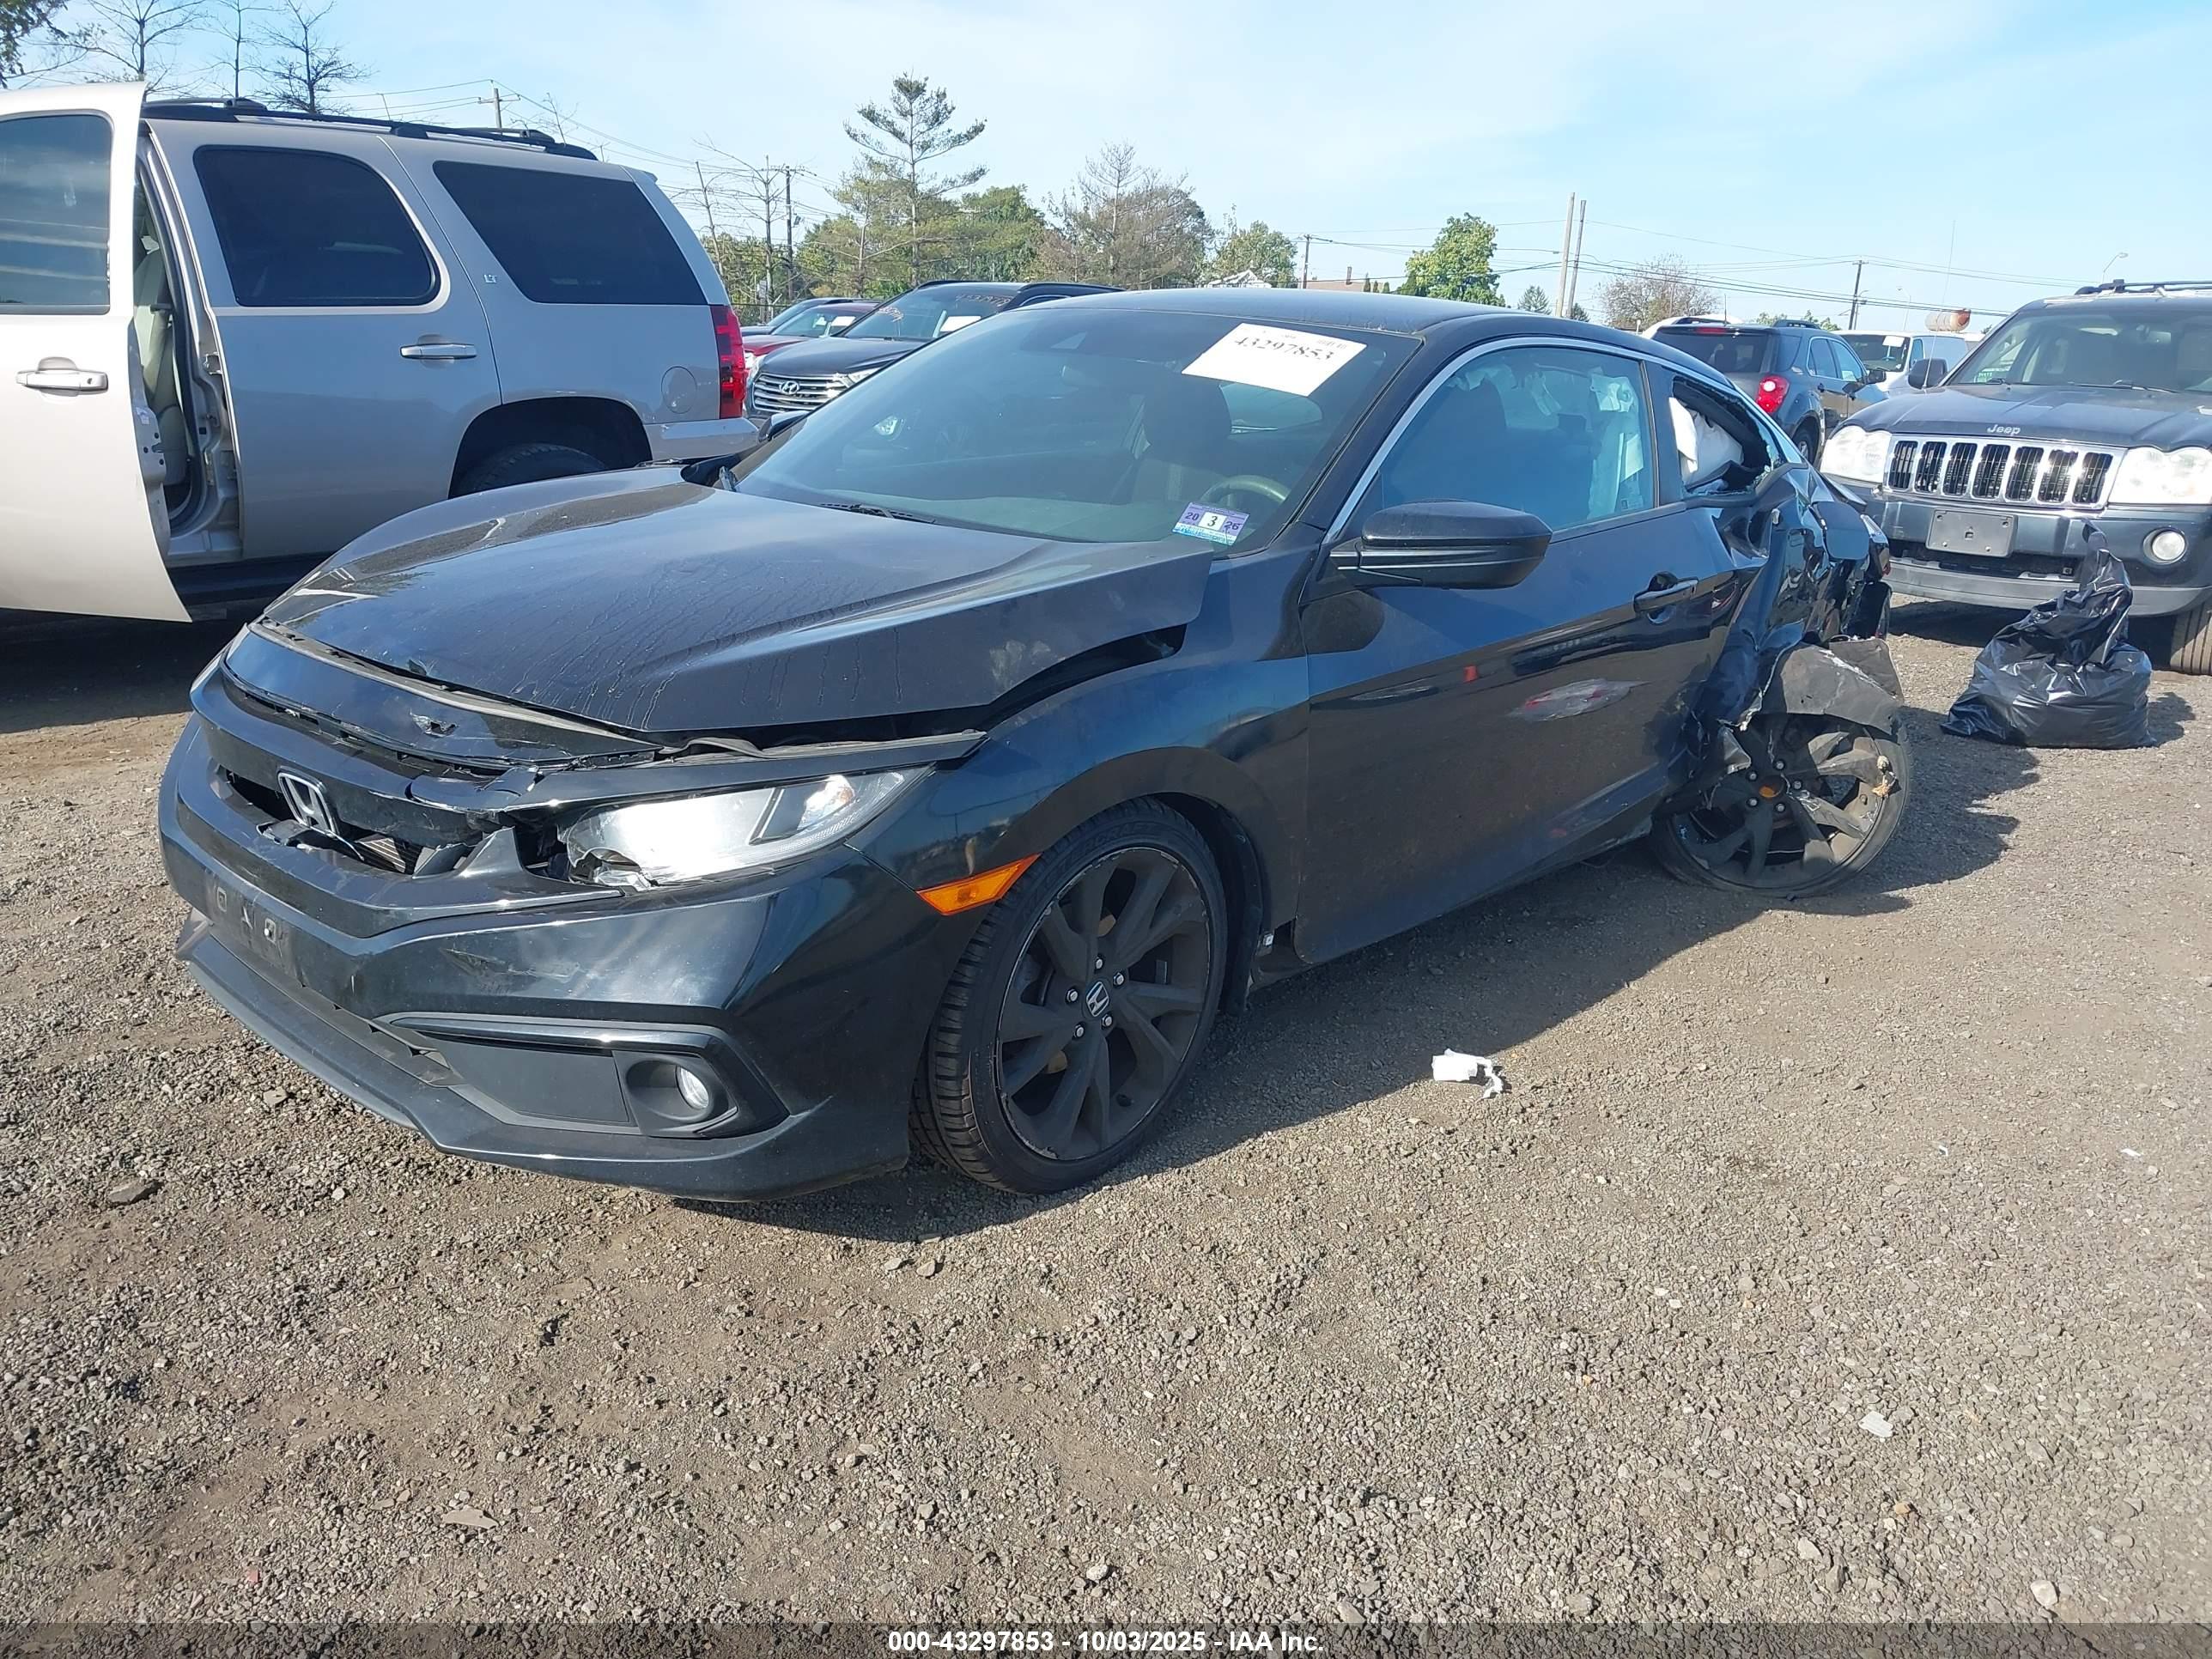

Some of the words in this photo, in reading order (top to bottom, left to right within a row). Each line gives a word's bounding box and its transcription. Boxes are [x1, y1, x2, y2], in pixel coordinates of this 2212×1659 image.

[1986, 423, 2021, 437] Jeep
[1184, 512, 1200, 521] 20
[1207, 515, 1218, 527] 3
[1224, 520, 1240, 531] 26
